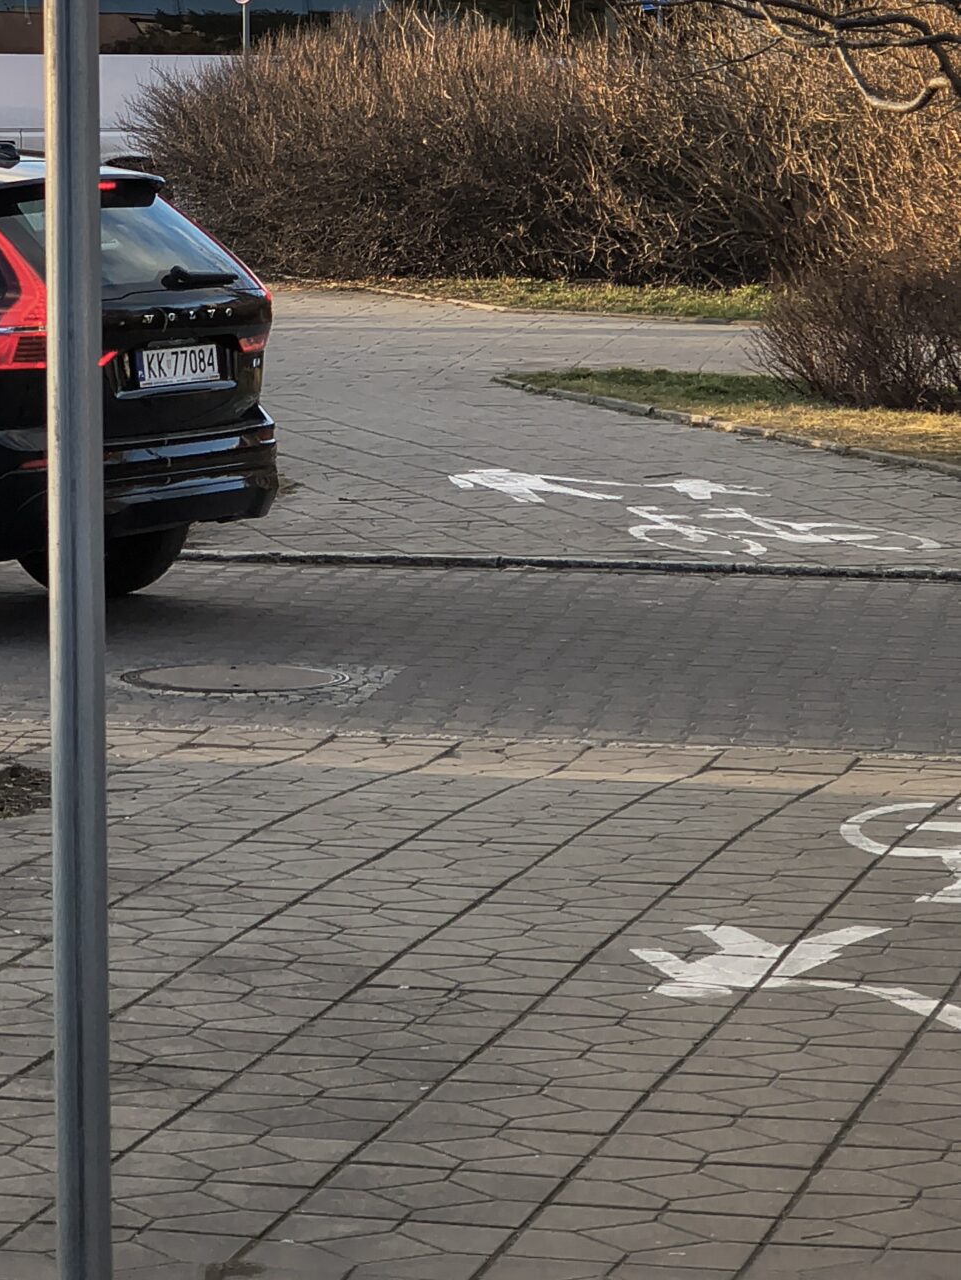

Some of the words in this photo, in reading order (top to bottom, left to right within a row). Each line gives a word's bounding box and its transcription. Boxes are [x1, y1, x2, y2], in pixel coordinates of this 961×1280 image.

[143, 308, 233, 323] VOLVO
[146, 352, 168, 379] KK
[170, 348, 216, 376] 77084
